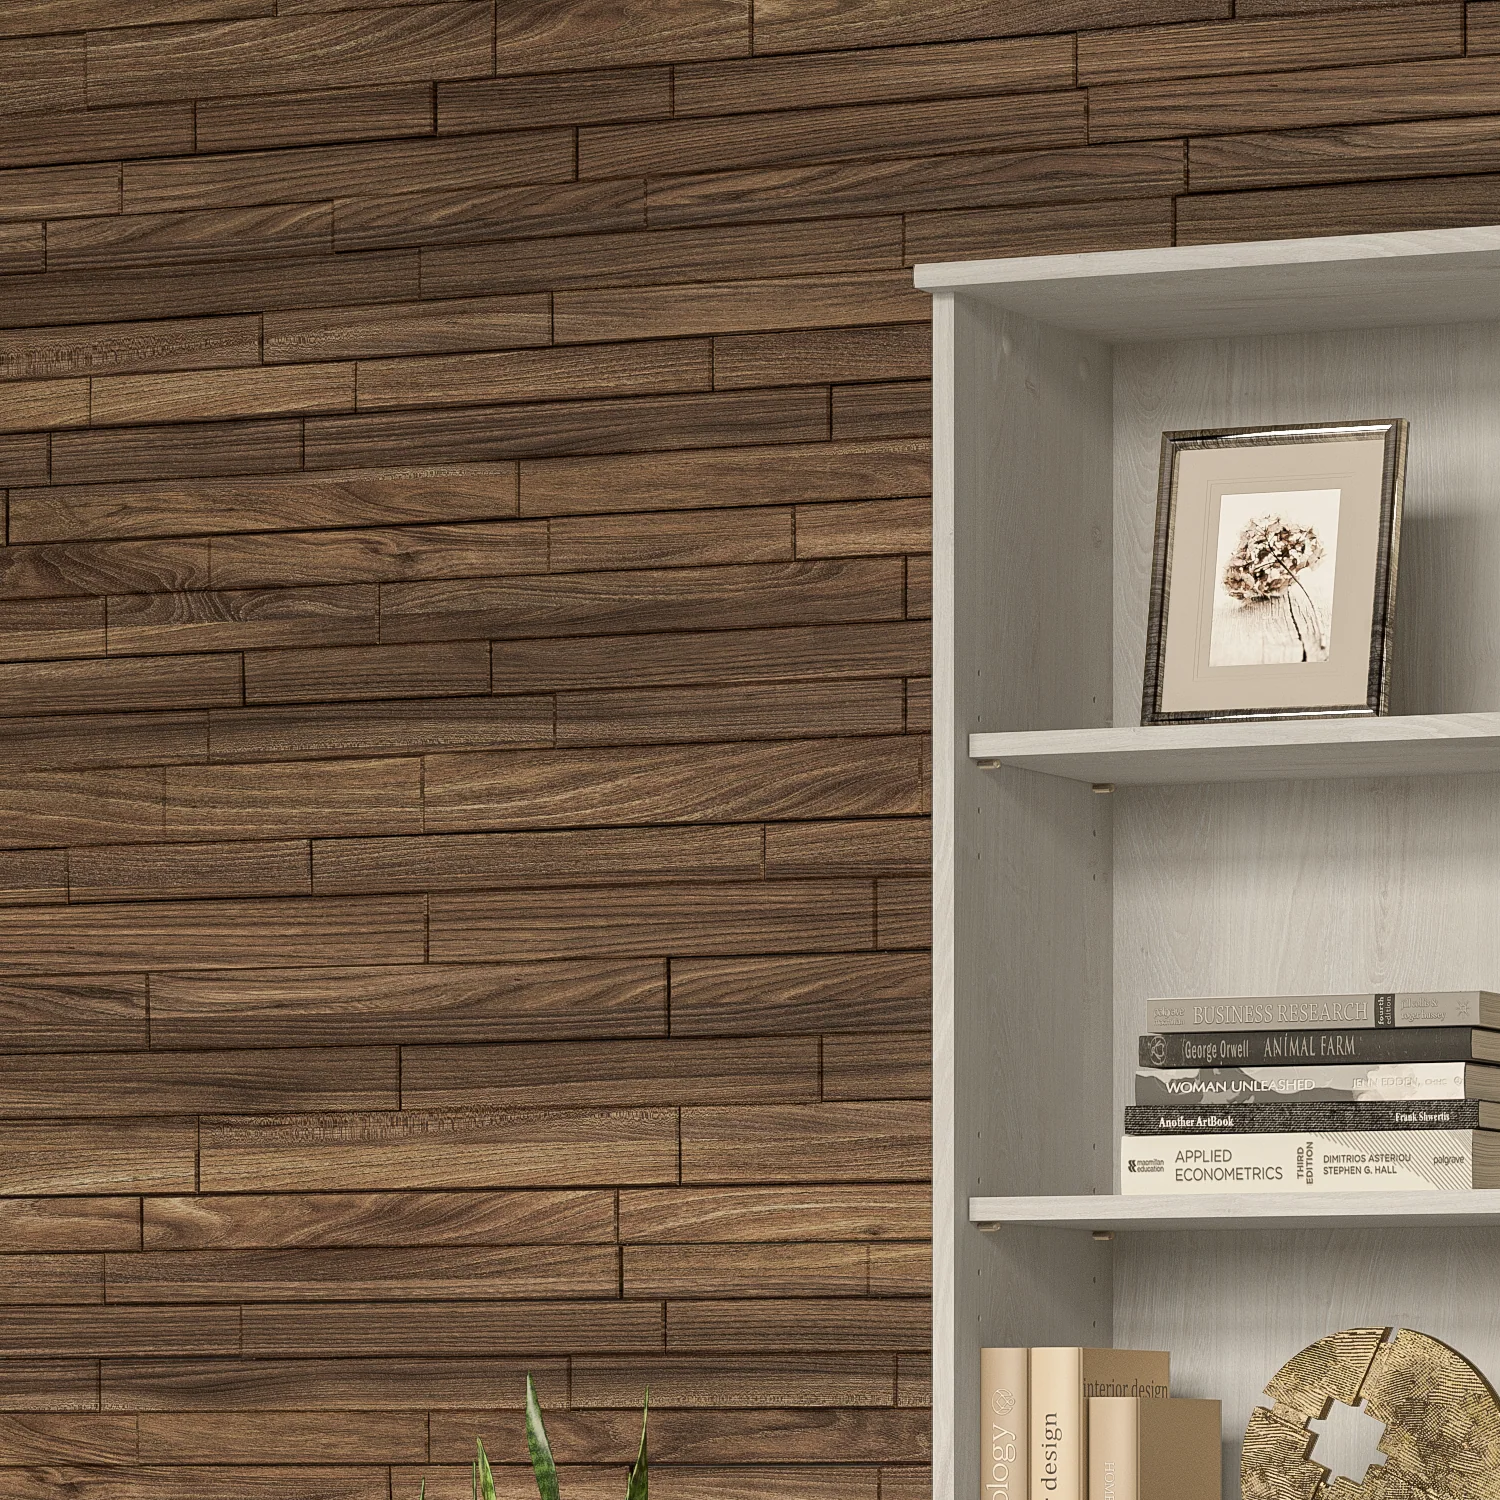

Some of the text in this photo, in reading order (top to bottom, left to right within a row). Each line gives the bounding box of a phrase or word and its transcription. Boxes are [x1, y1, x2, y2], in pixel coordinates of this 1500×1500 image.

[1193, 1001, 1369, 1025] BUSINESS RESEARCH
[1384, 996, 1392, 1025] edition
[1184, 1039, 1250, 1063] George Orwell
[1321, 1034, 1356, 1056] FARM
[1165, 1079, 1316, 1094] WOMAN UNLEASHED
[1158, 1115, 1235, 1128] Another ArtBook
[1395, 1111, 1417, 1122] Frank
[1174, 1149, 1233, 1164] APPLIED
[1297, 1146, 1305, 1180] THIRD
[1306, 1141, 1314, 1185] EDITION
[1323, 1153, 1412, 1164] DIMITRIOS ASTERIOU
[1433, 1155, 1465, 1166] palgrave
[1136, 1165, 1165, 1173] education
[1175, 1166, 1284, 1182] ECONOMETRICS
[1323, 1165, 1398, 1175] STEPHEN G. HALL
[1083, 1378, 1168, 1399] interior design
[1040, 1412, 1063, 1491] design
